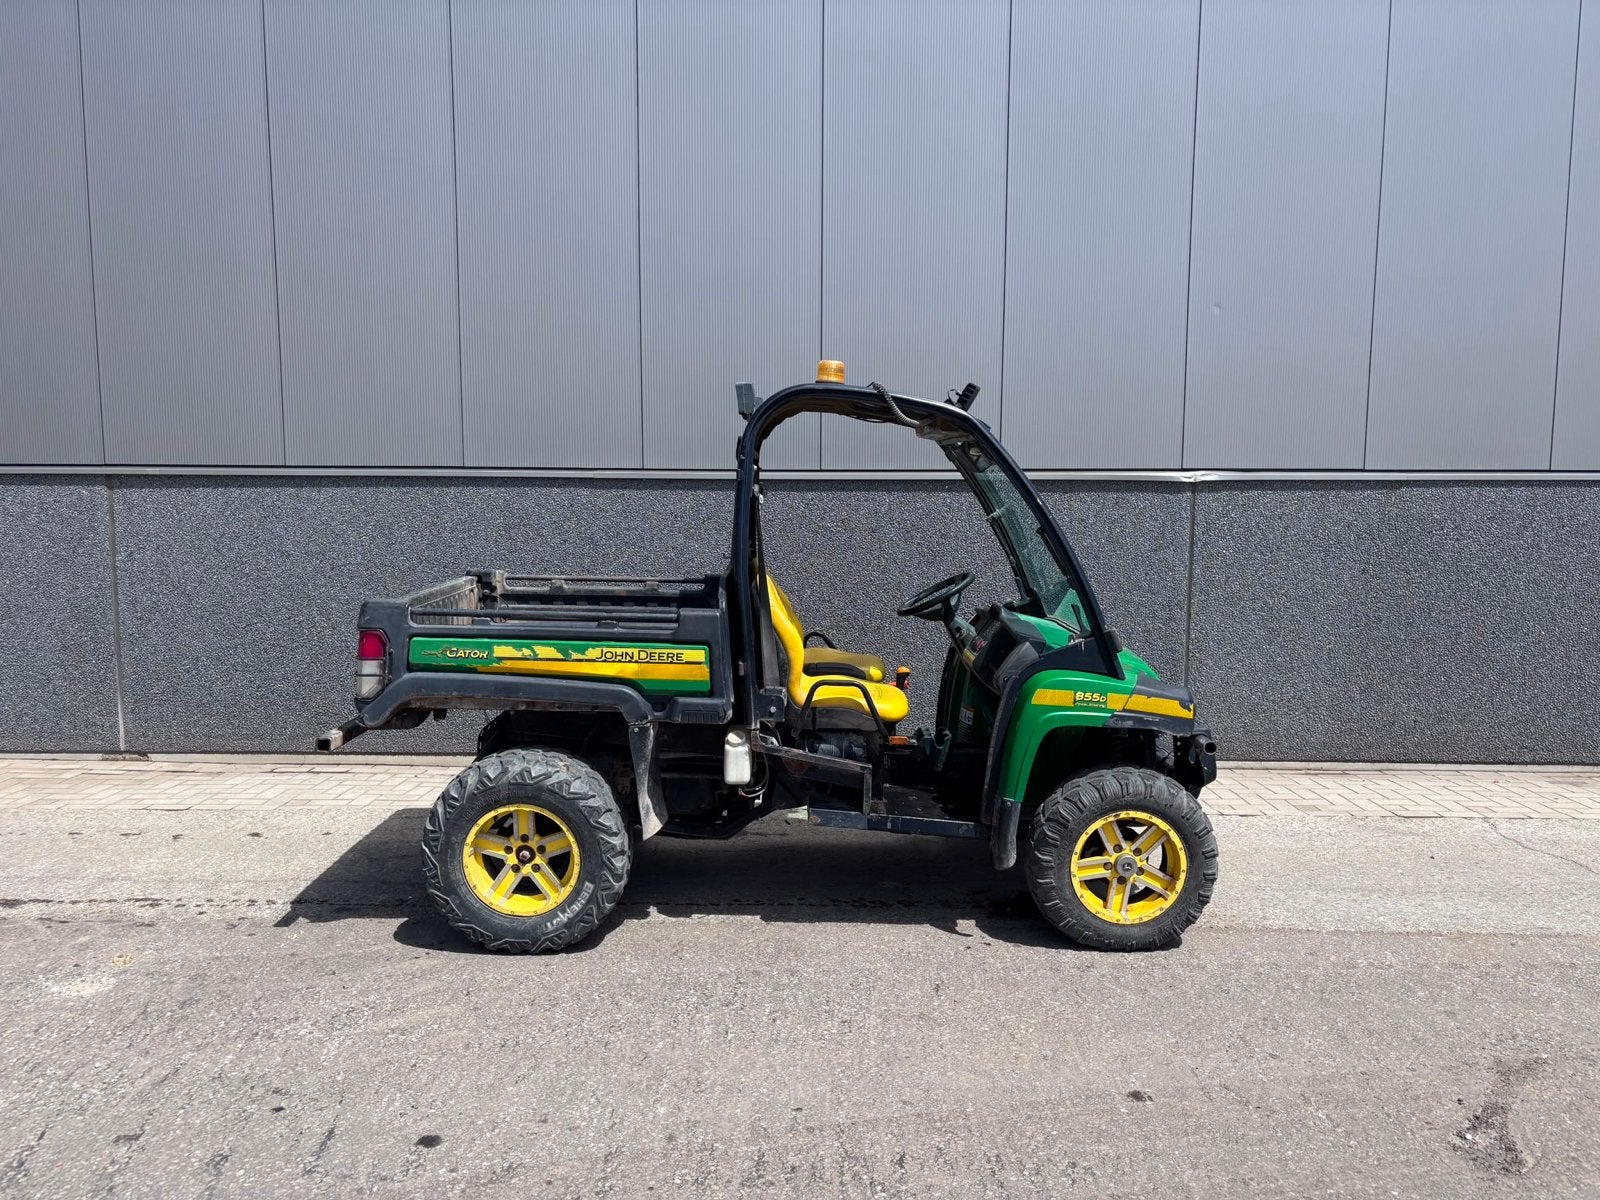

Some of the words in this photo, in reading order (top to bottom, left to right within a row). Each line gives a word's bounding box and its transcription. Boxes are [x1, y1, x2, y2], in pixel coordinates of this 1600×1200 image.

[446, 647, 488, 659] GATOR
[595, 648, 634, 661] JOHN
[637, 649, 684, 662] DEERE
